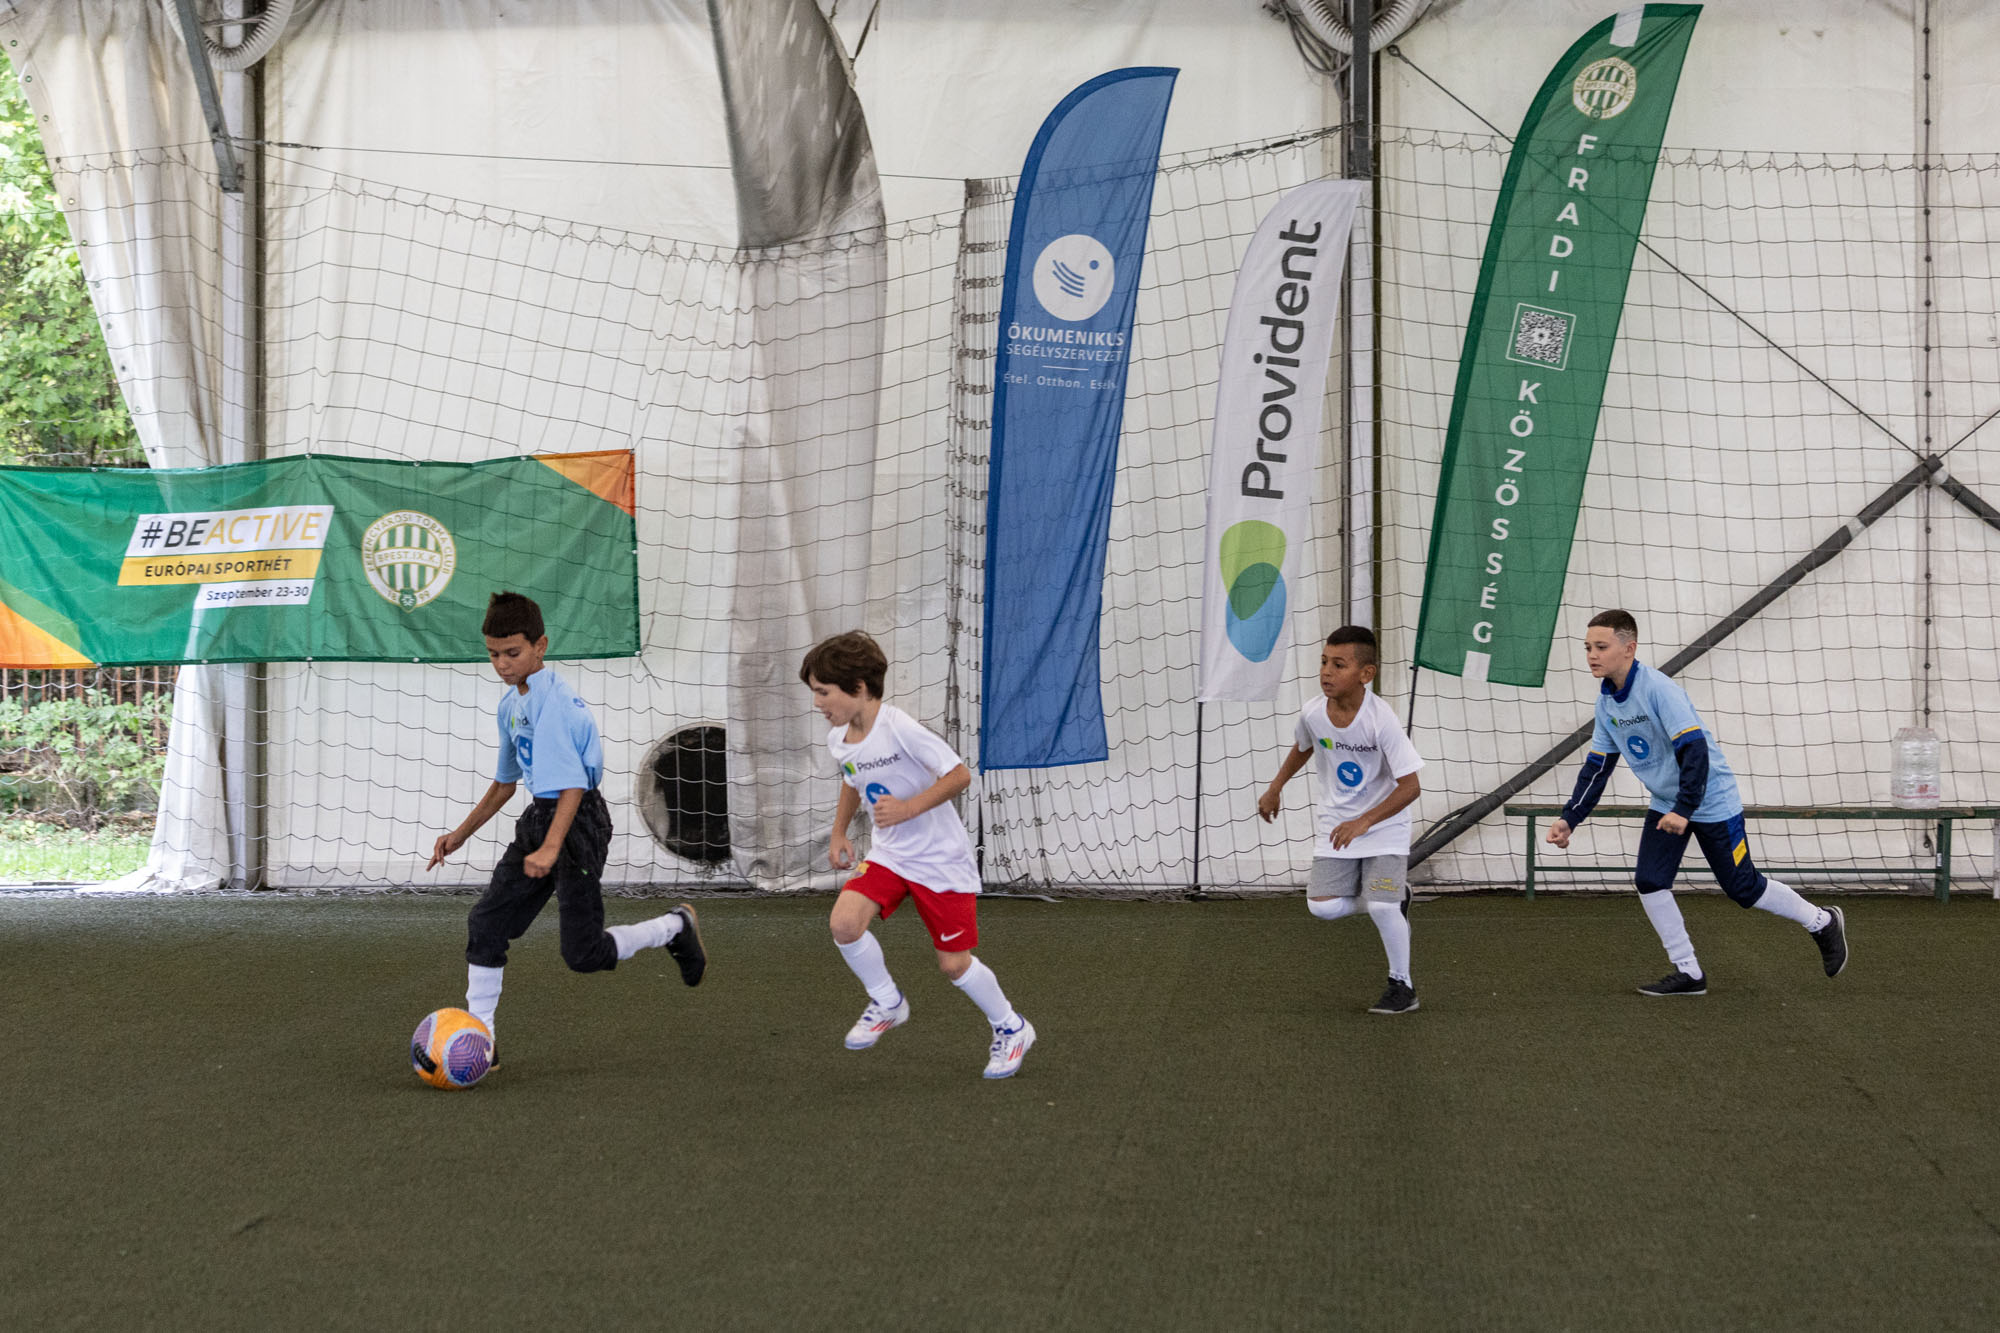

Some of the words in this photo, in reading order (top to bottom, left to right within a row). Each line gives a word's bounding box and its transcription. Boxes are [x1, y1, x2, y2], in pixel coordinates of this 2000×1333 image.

[1547, 133, 1599, 293] FRADI
[1007, 322, 1125, 346] ÖKUMENIKUS
[1241, 218, 1322, 500] Provident
[1003, 371, 1032, 385] Étel.
[1037, 375, 1085, 389] Otthon.
[1472, 379, 1542, 645] KÖZÖSSÉG
[141, 512, 323, 548] #BEACTIVE
[145, 561, 211, 577] EURÓPAI
[214, 555, 292, 575] SPORTHÉT
[206, 587, 272, 602] Szeptember
[275, 586, 309, 597] 23-30
[1335, 741, 1379, 753] Provident
[857, 753, 901, 773] Provident
